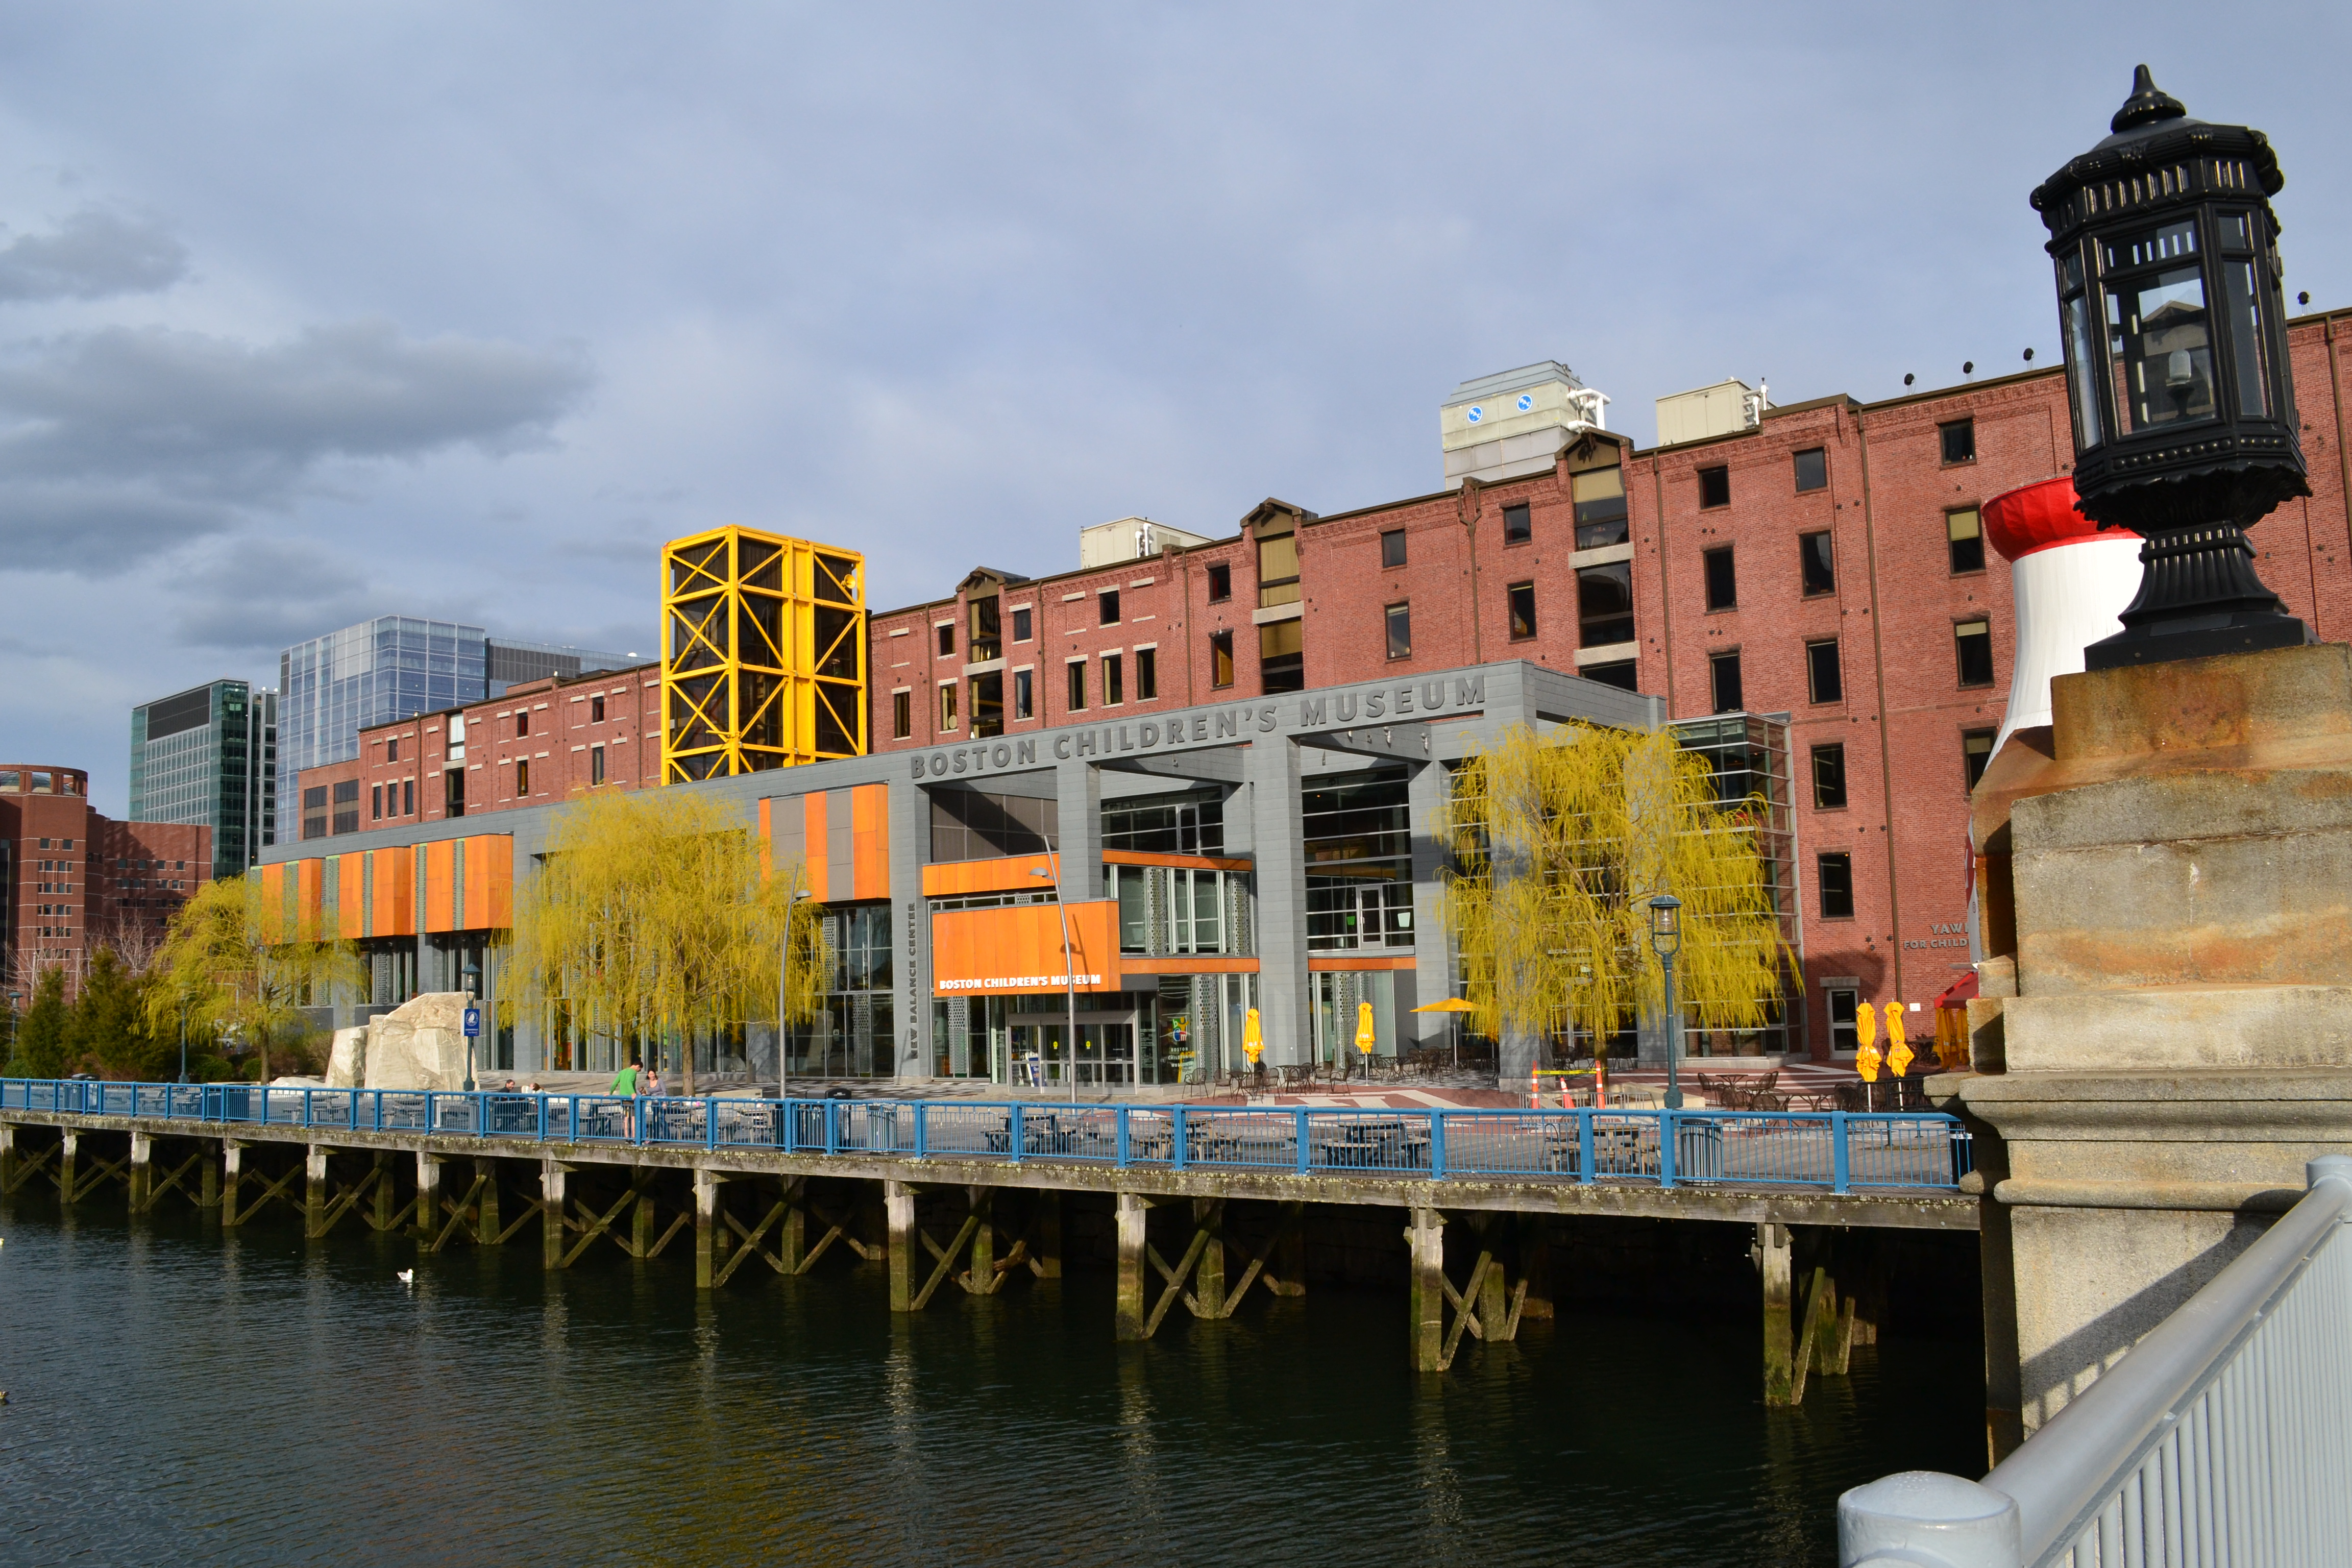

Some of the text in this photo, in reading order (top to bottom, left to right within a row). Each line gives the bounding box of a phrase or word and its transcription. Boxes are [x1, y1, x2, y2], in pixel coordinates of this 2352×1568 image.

[1520, 398, 1531, 407] BAC
[1470, 409, 1480, 418] BAC
[911, 674, 1485, 779] BOSTON CHILDREN'S MUSEUM
[908, 902, 916, 956] CENTER
[1904, 938, 1969, 949] FOR CHILD
[940, 978, 982, 990] BOSTON
[984, 976, 1048, 989] CHILDREN'S
[909, 960, 918, 1023] BALANCE
